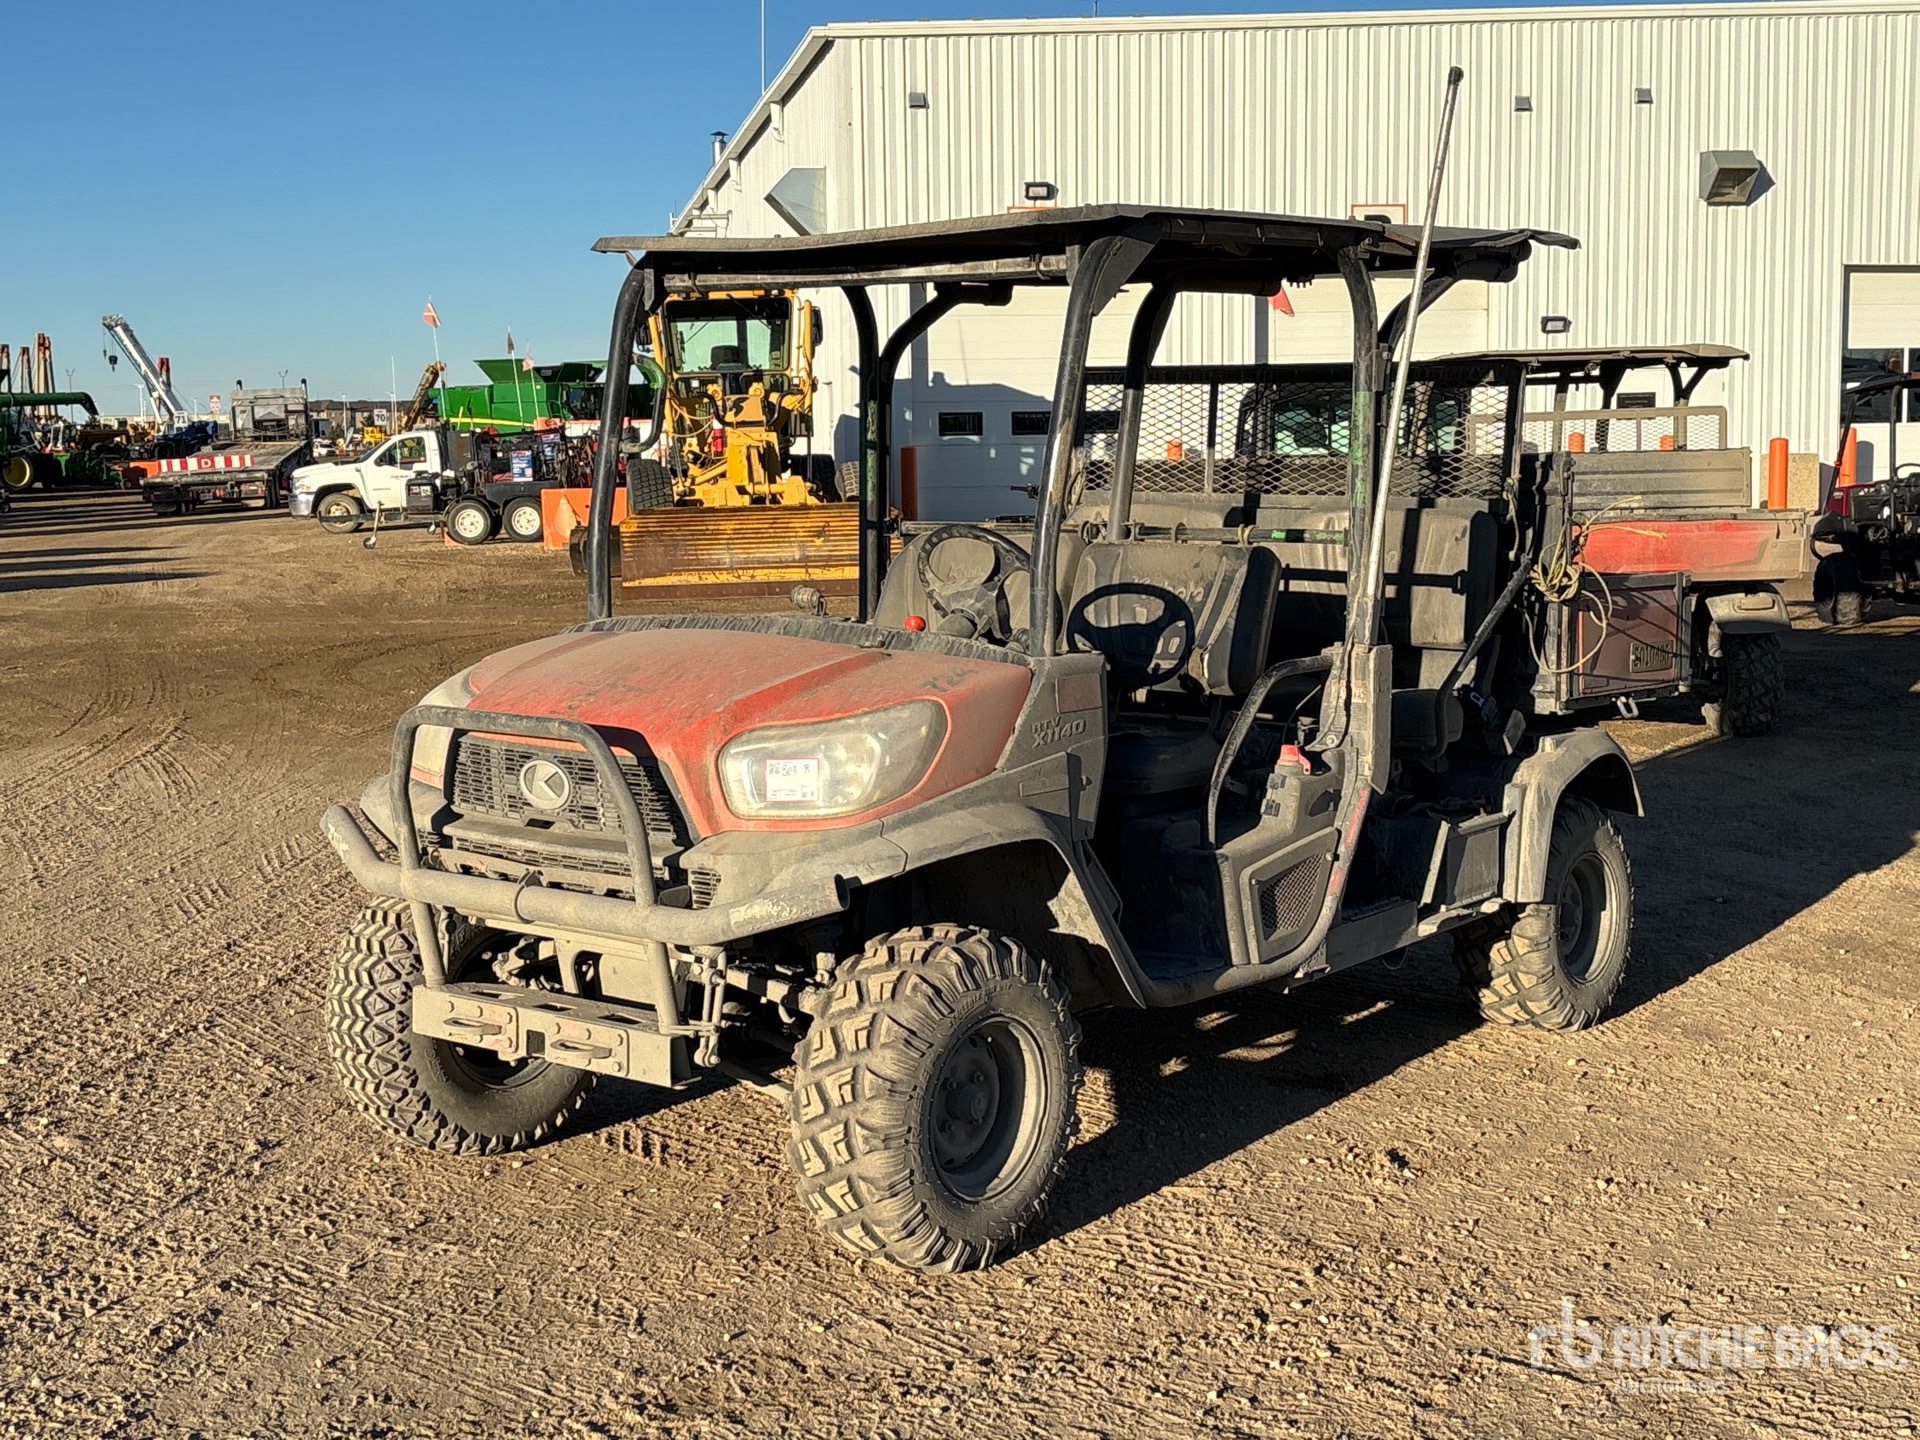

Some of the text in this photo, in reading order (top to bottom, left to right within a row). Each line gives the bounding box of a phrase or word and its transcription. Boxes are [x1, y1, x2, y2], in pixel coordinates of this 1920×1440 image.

[174, 415, 187, 424] 71
[375, 413, 386, 423] 70
[200, 458, 212, 469] D
[1031, 716, 1061, 734] RTV
[1031, 719, 1087, 749] X1140
